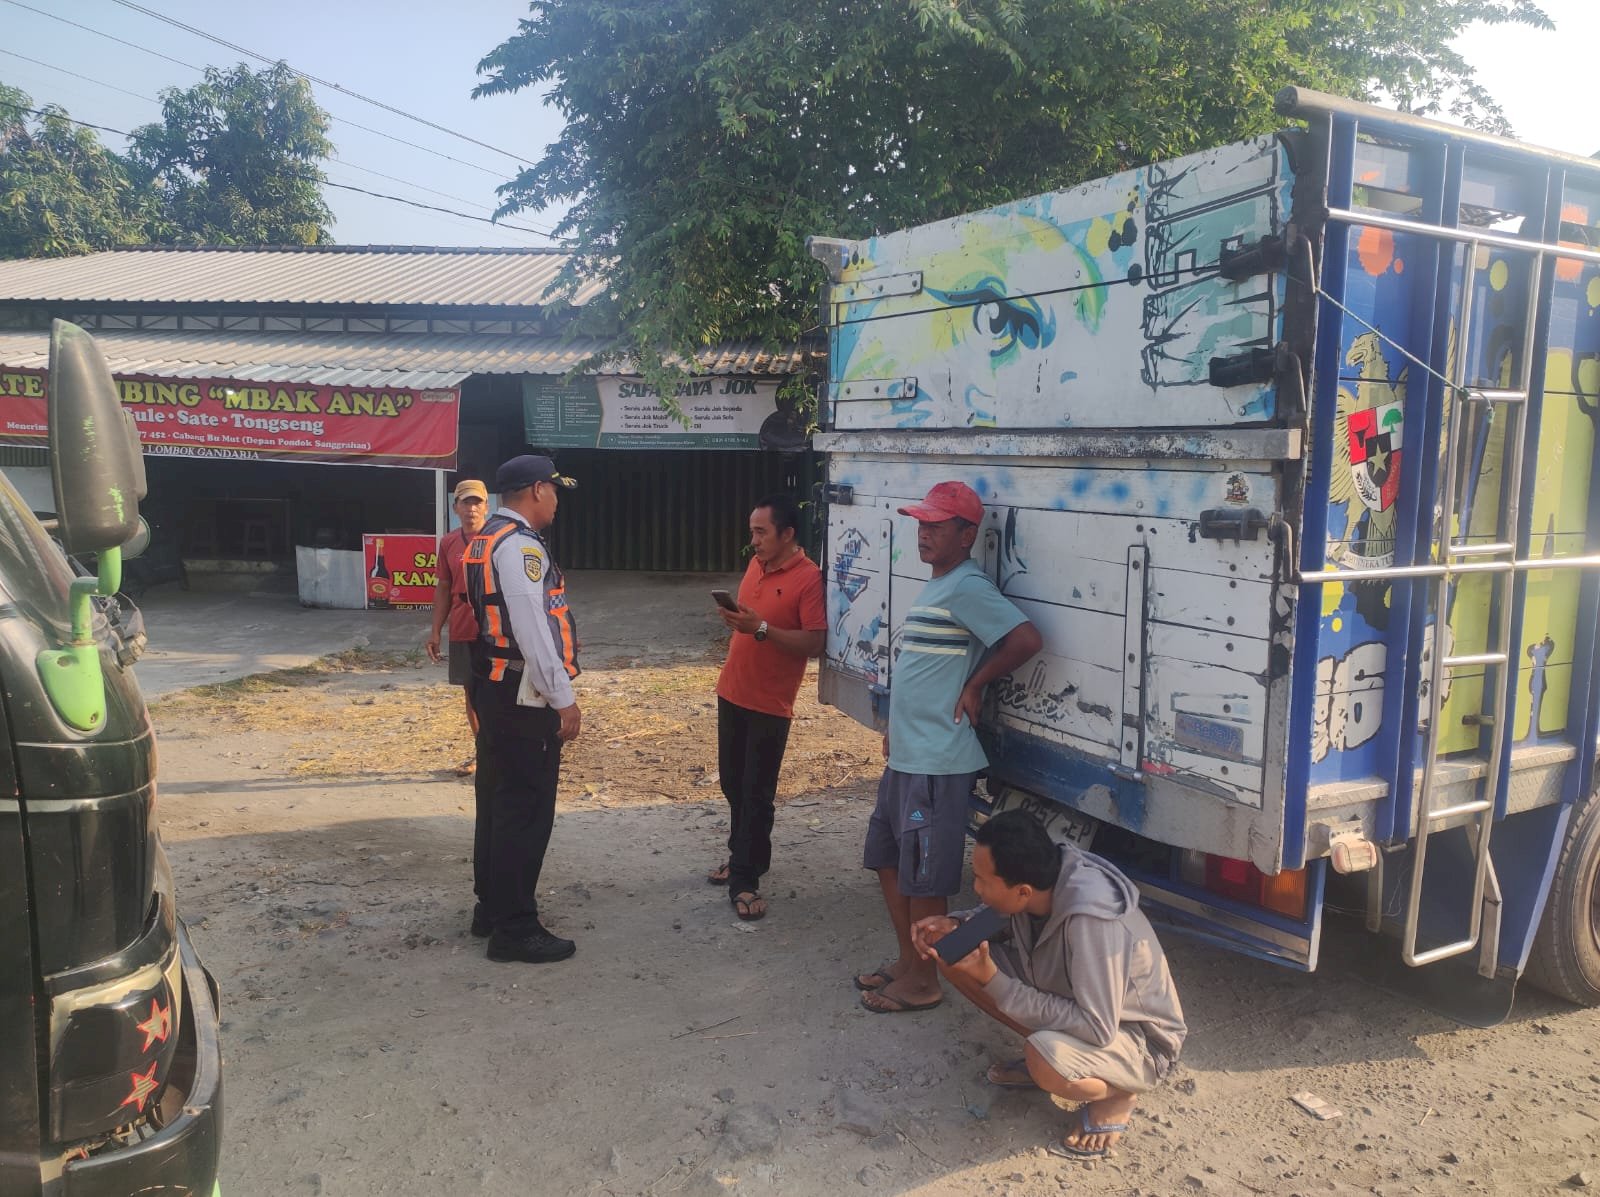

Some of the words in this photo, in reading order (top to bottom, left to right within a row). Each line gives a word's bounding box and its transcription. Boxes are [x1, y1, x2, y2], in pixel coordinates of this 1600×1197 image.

[114, 380, 202, 407] BING
[720, 380, 757, 394] JOK
[177, 410, 219, 426] Sate
[231, 413, 324, 435] Tongseng
[173, 432, 205, 443] Cabang
[207, 434, 220, 442] Bu
[222, 434, 240, 443] Mut
[148, 445, 194, 456] LOMBOK
[197, 447, 259, 459] GANDARIA
